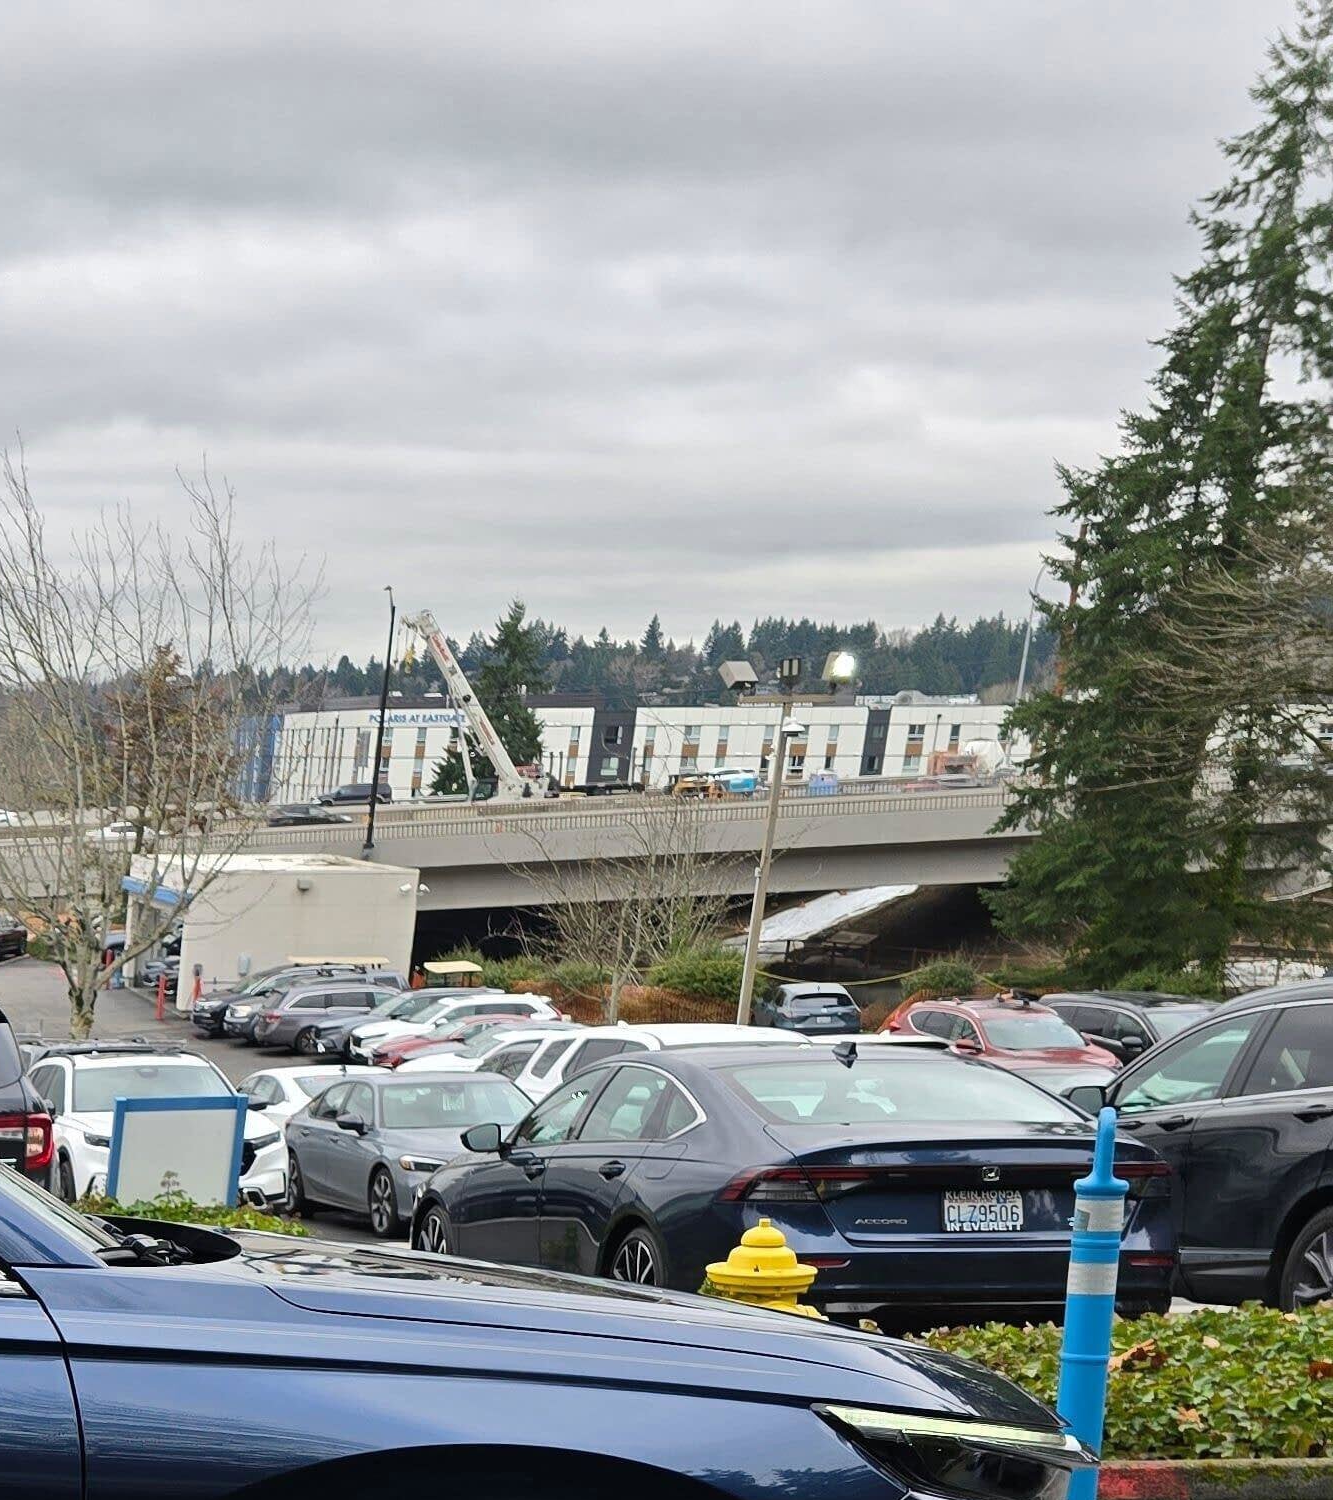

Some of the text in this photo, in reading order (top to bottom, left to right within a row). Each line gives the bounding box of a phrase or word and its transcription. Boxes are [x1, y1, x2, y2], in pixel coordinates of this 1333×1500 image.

[369, 714, 406, 724] POARIS
[409, 714, 420, 723] AT
[945, 1190, 1022, 1200] KLEIN HONDA
[947, 1204, 1020, 1223] CLZ9506
[947, 1222, 1021, 1232] IN EVERETT
